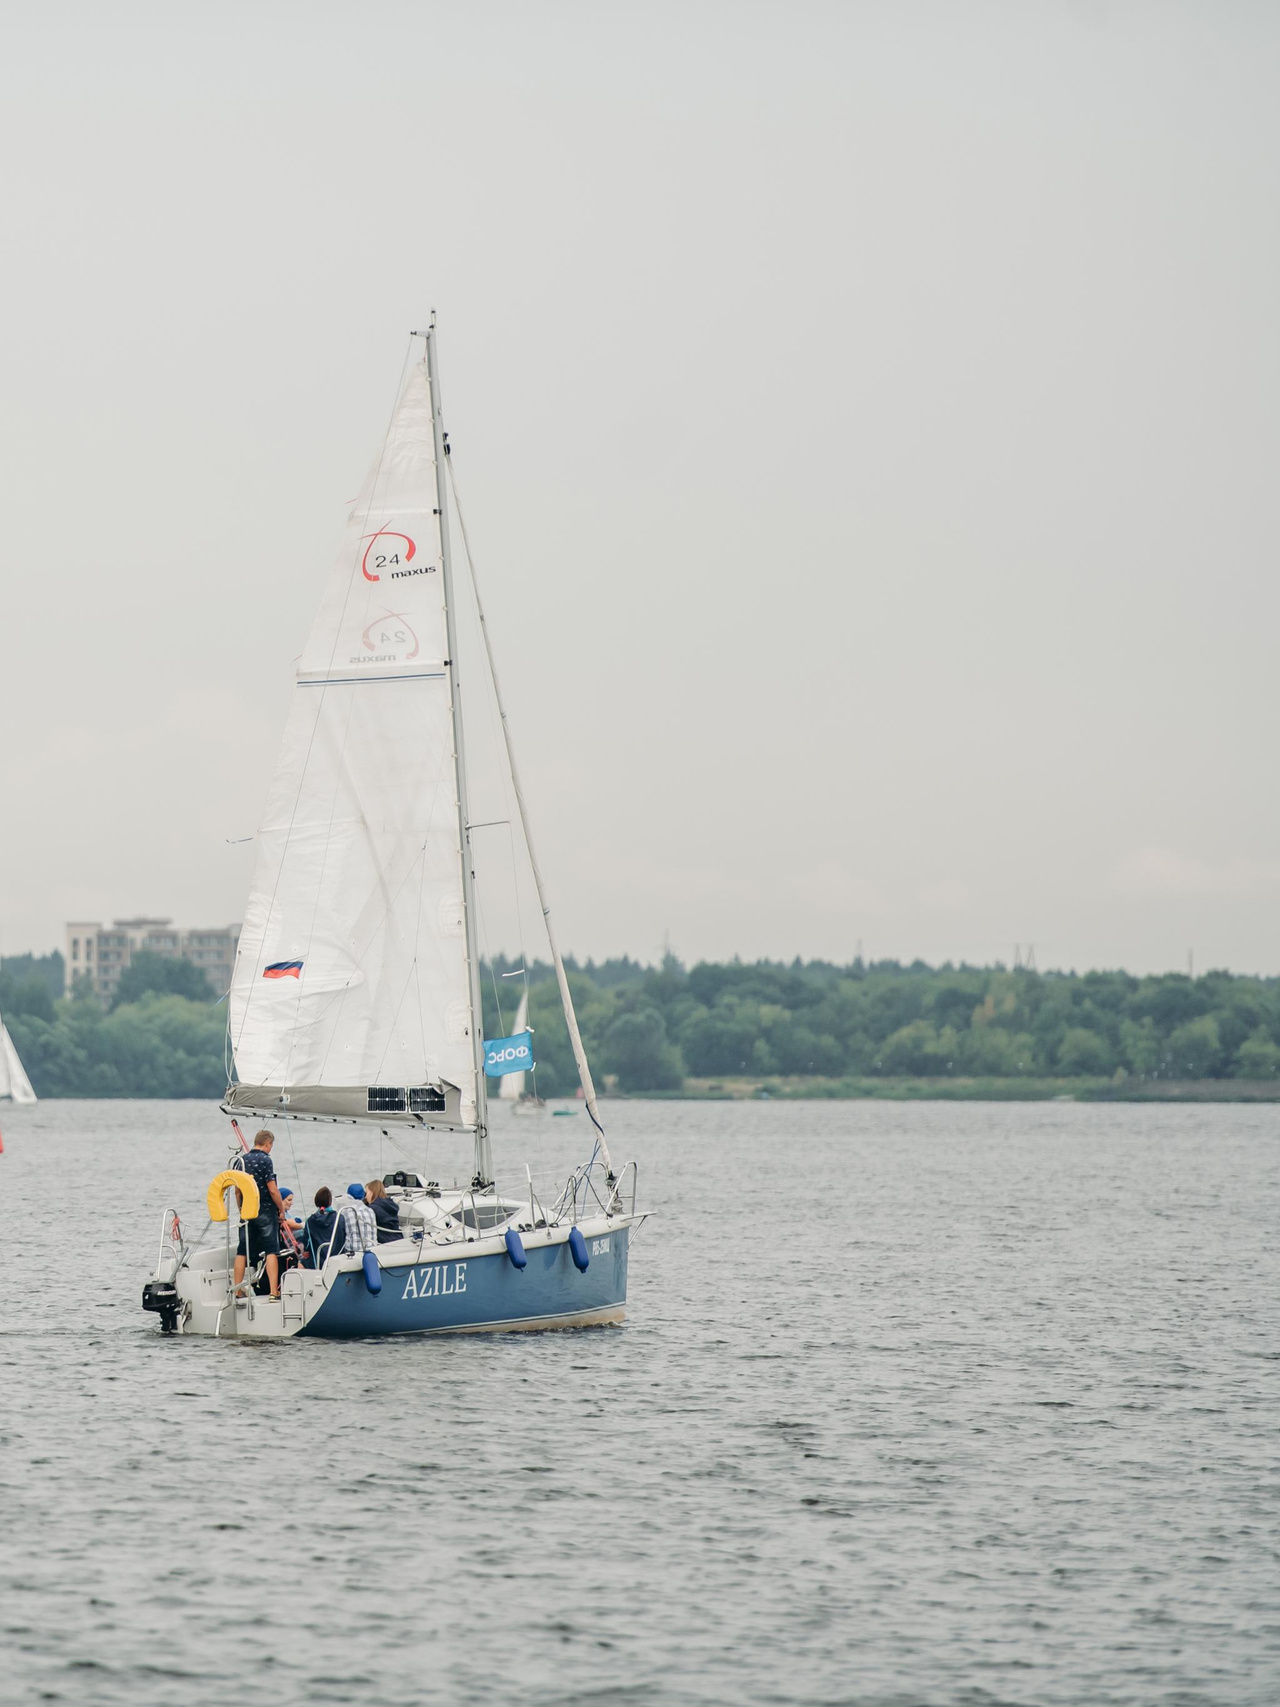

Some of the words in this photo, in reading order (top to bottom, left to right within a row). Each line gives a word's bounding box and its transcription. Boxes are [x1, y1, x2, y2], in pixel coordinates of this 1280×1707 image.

[374, 553, 400, 568] 24
[391, 566, 437, 579] maxus
[401, 1262, 467, 1300] AZILE
